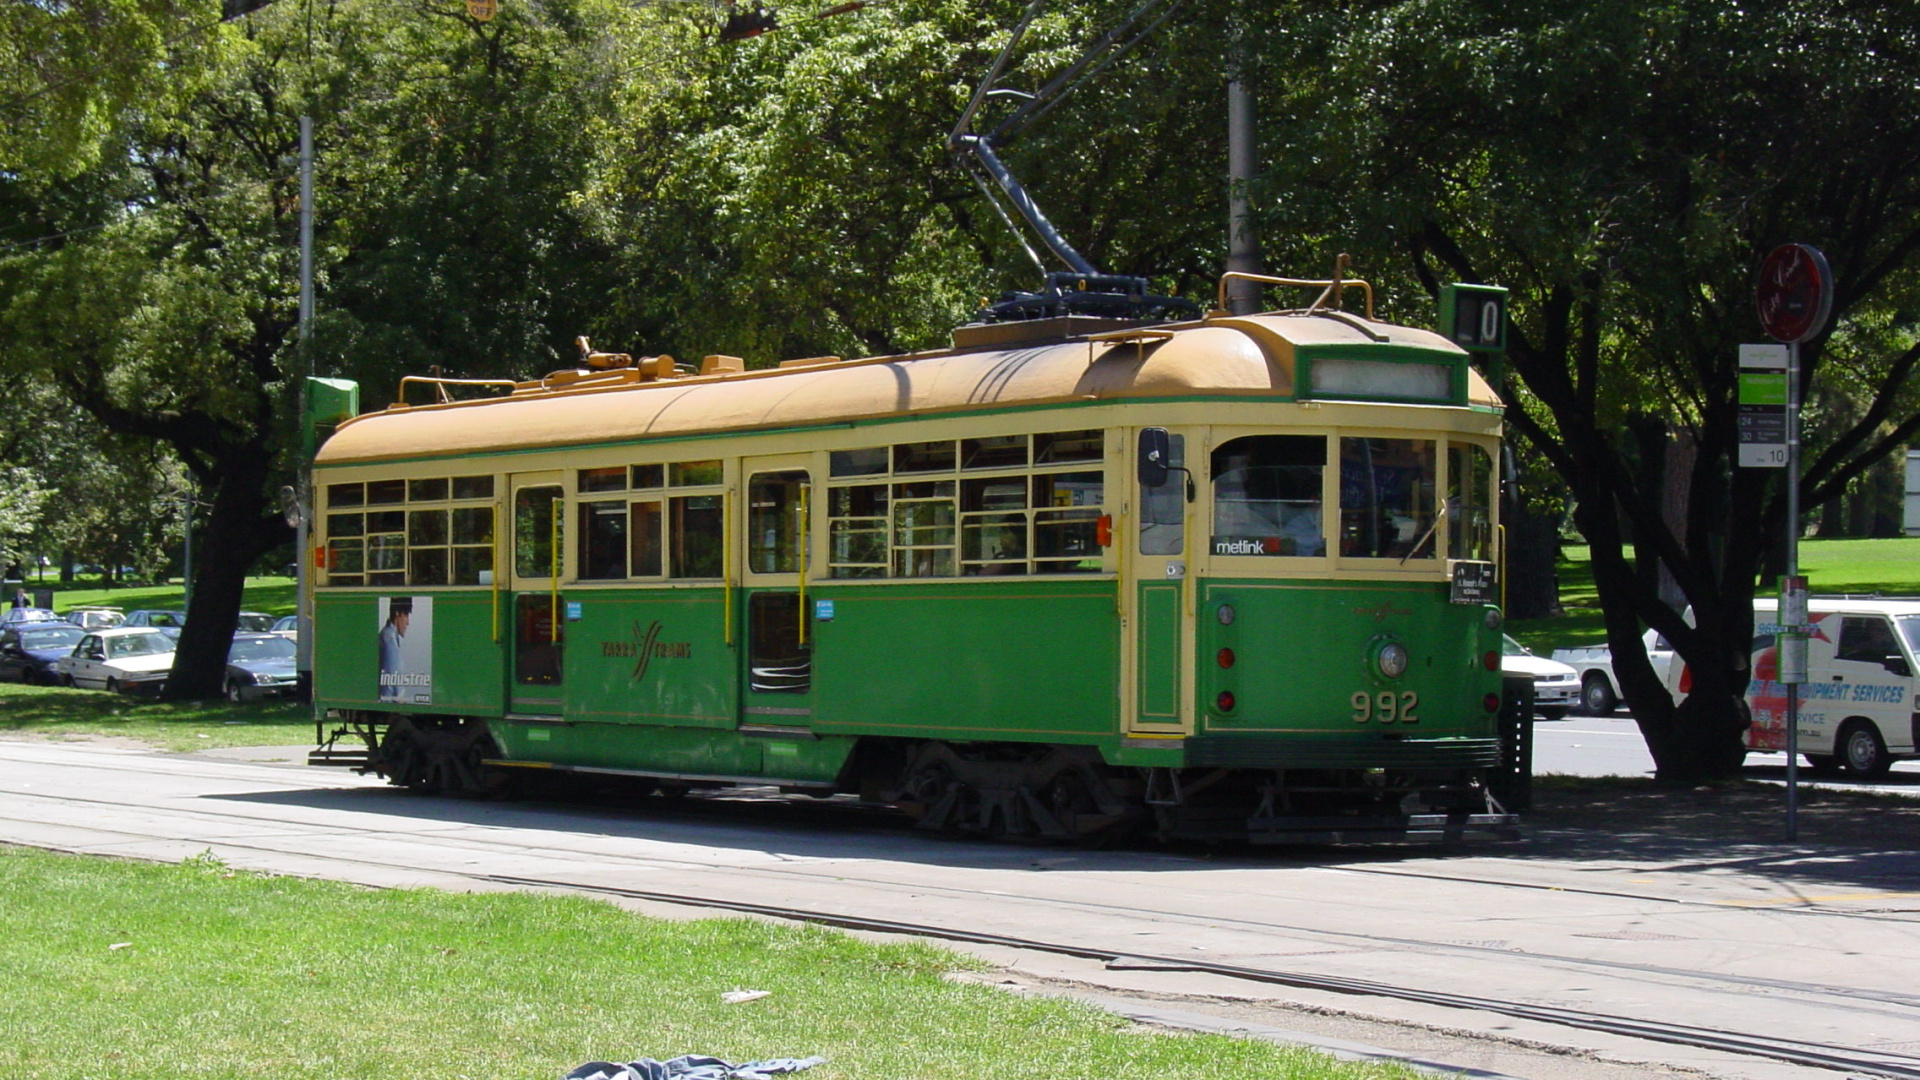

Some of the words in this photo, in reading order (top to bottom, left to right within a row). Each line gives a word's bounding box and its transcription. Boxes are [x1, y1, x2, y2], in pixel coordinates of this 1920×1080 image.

[471, 5, 492, 16] OFF
[1770, 449, 1784, 463] 10
[1216, 540, 1264, 554] metlink
[653, 641, 692, 658] TRAMS
[380, 669, 431, 686] industrie
[1853, 685, 1904, 704] SERVICES
[1350, 691, 1419, 724] 992
